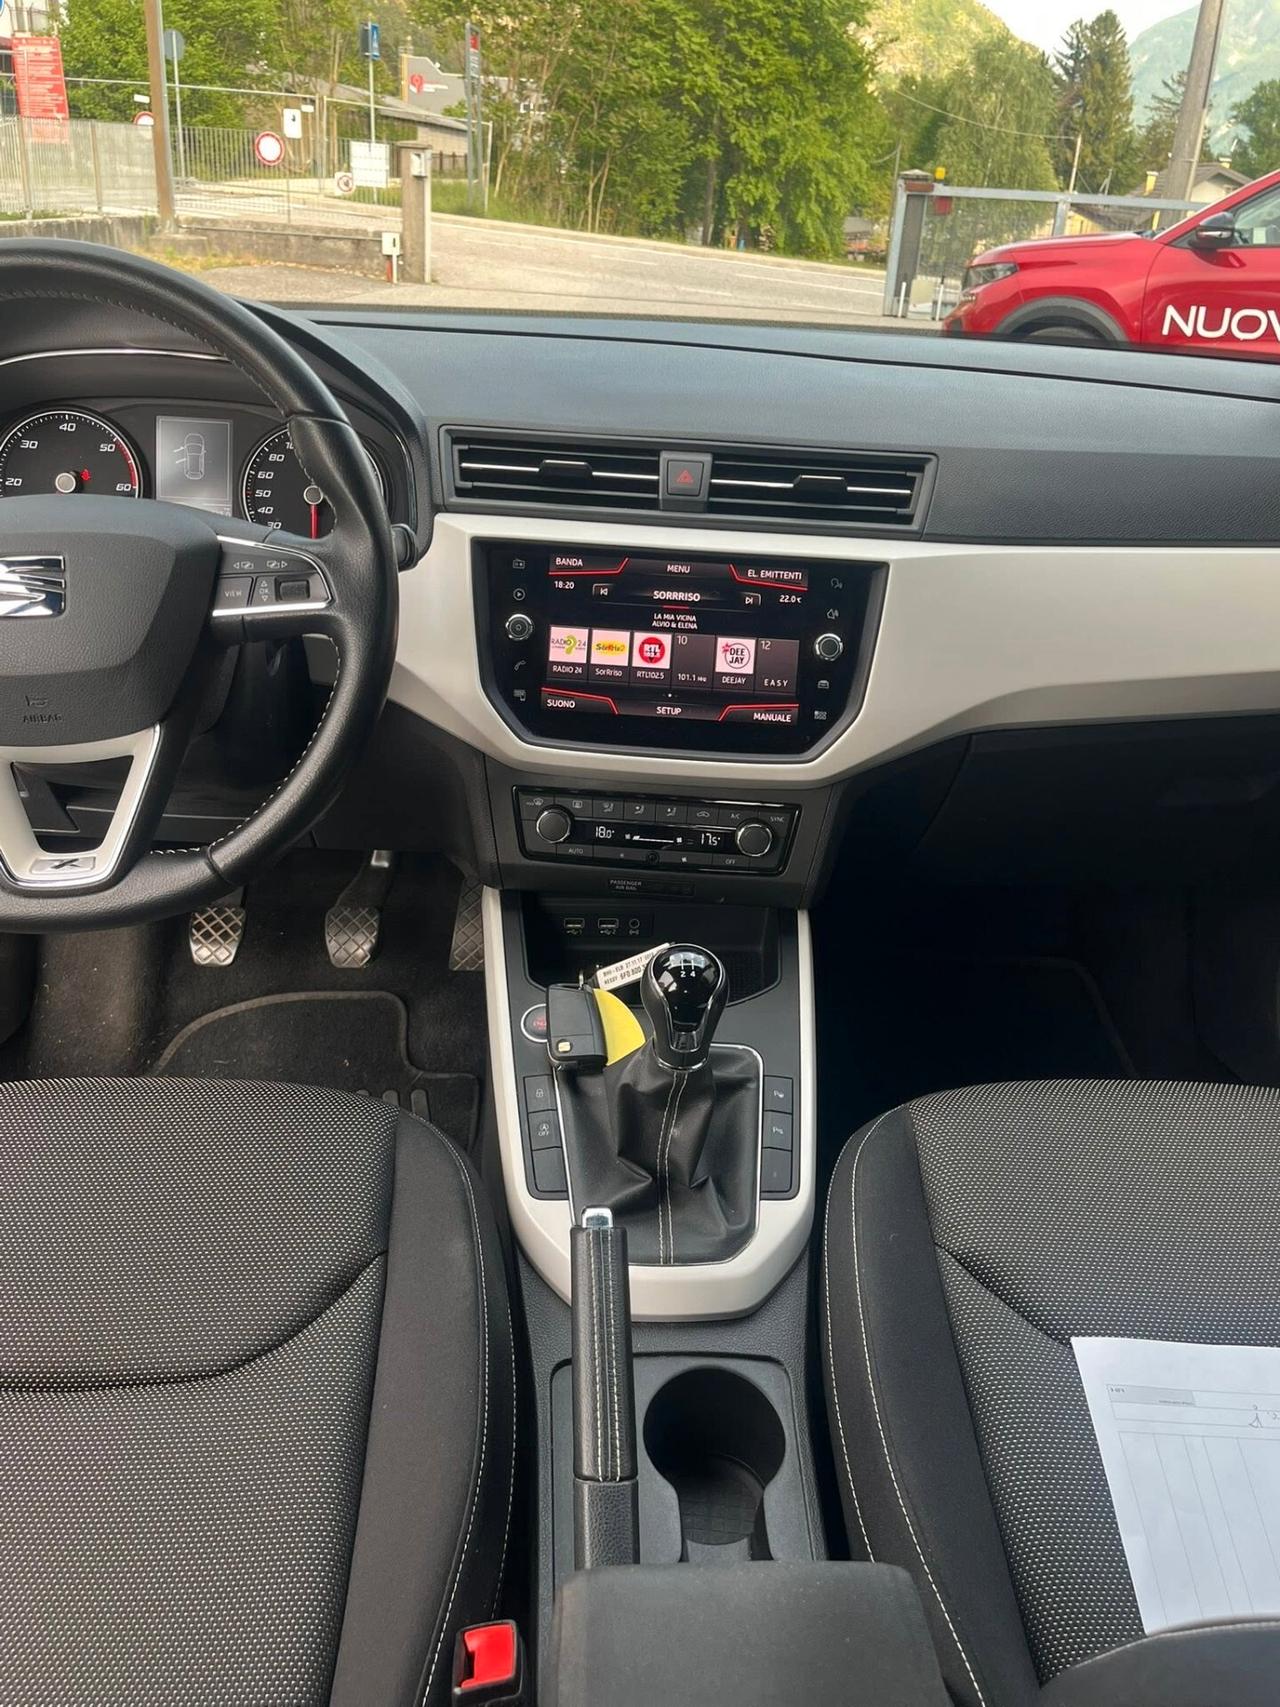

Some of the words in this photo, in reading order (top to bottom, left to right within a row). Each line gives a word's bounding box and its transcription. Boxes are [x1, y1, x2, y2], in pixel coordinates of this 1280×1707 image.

[59, 423, 76, 432] 40
[20, 440, 38, 449] 30
[99, 444, 116, 452] 50
[268, 454, 285, 462] 80
[258, 471, 274, 480] 60
[5, 478, 22, 486] 20
[116, 484, 132, 492] 60
[254, 489, 272, 498] 50
[258, 506, 274, 515] 40
[267, 521, 282, 530] 30
[555, 557, 584, 567] BANDA
[666, 564, 690, 574] MENU
[760, 570, 802, 580] EMITTENTI
[554, 580, 575, 590] 18:20
[224, 590, 242, 598] VIEW
[653, 590, 701, 602] SORRRISO
[676, 614, 697, 622] VICINA
[652, 620, 670, 628] ALVIO
[678, 622, 698, 630] ELENA
[676, 635, 688, 645] 10
[760, 640, 772, 650] 12
[729, 647, 745, 656] DEE
[728, 656, 744, 664] JAY
[552, 666, 574, 674] RADIO
[636, 670, 664, 680] RTL102.5
[678, 673, 696, 682] 101.1
[722, 676, 746, 684] DEEJAY
[546, 698, 576, 708] SUONO
[656, 706, 682, 716] SETUP
[753, 712, 792, 723] MANUALE
[568, 847, 584, 855] AUTO
[680, 970, 686, 978] 2
[690, 970, 696, 978] 4
